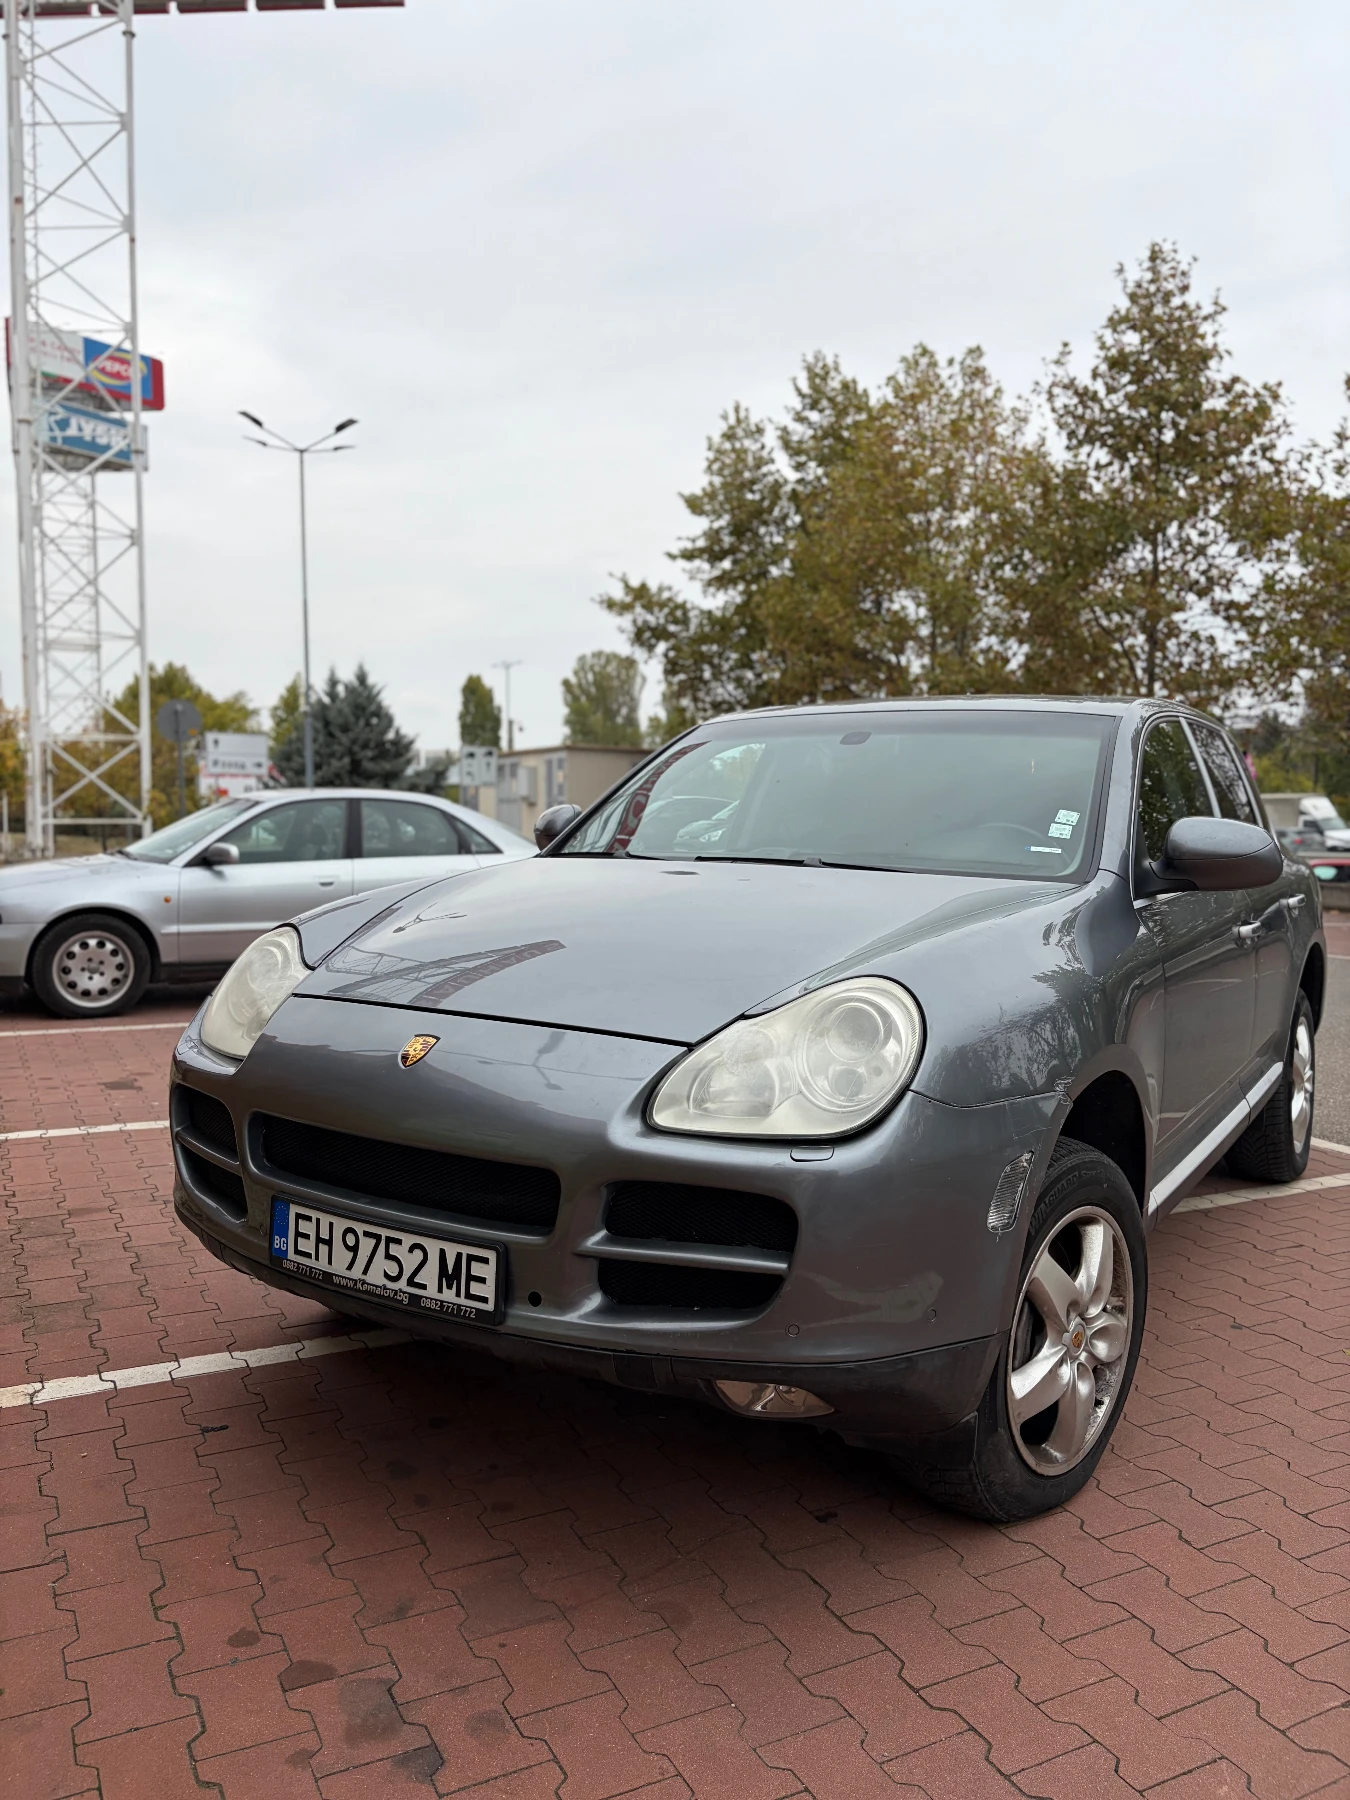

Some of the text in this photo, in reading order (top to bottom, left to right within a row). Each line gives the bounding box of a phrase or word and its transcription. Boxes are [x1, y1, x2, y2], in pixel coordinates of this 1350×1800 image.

[97, 358, 140, 379] PEPC
[273, 1235, 288, 1251] BG
[293, 1212, 491, 1305] EH 9752 ME
[298, 1264, 310, 1276] 771
[420, 1297, 441, 1310] 0882
[442, 1302, 458, 1315] 771
[459, 1306, 476, 1318] 772
